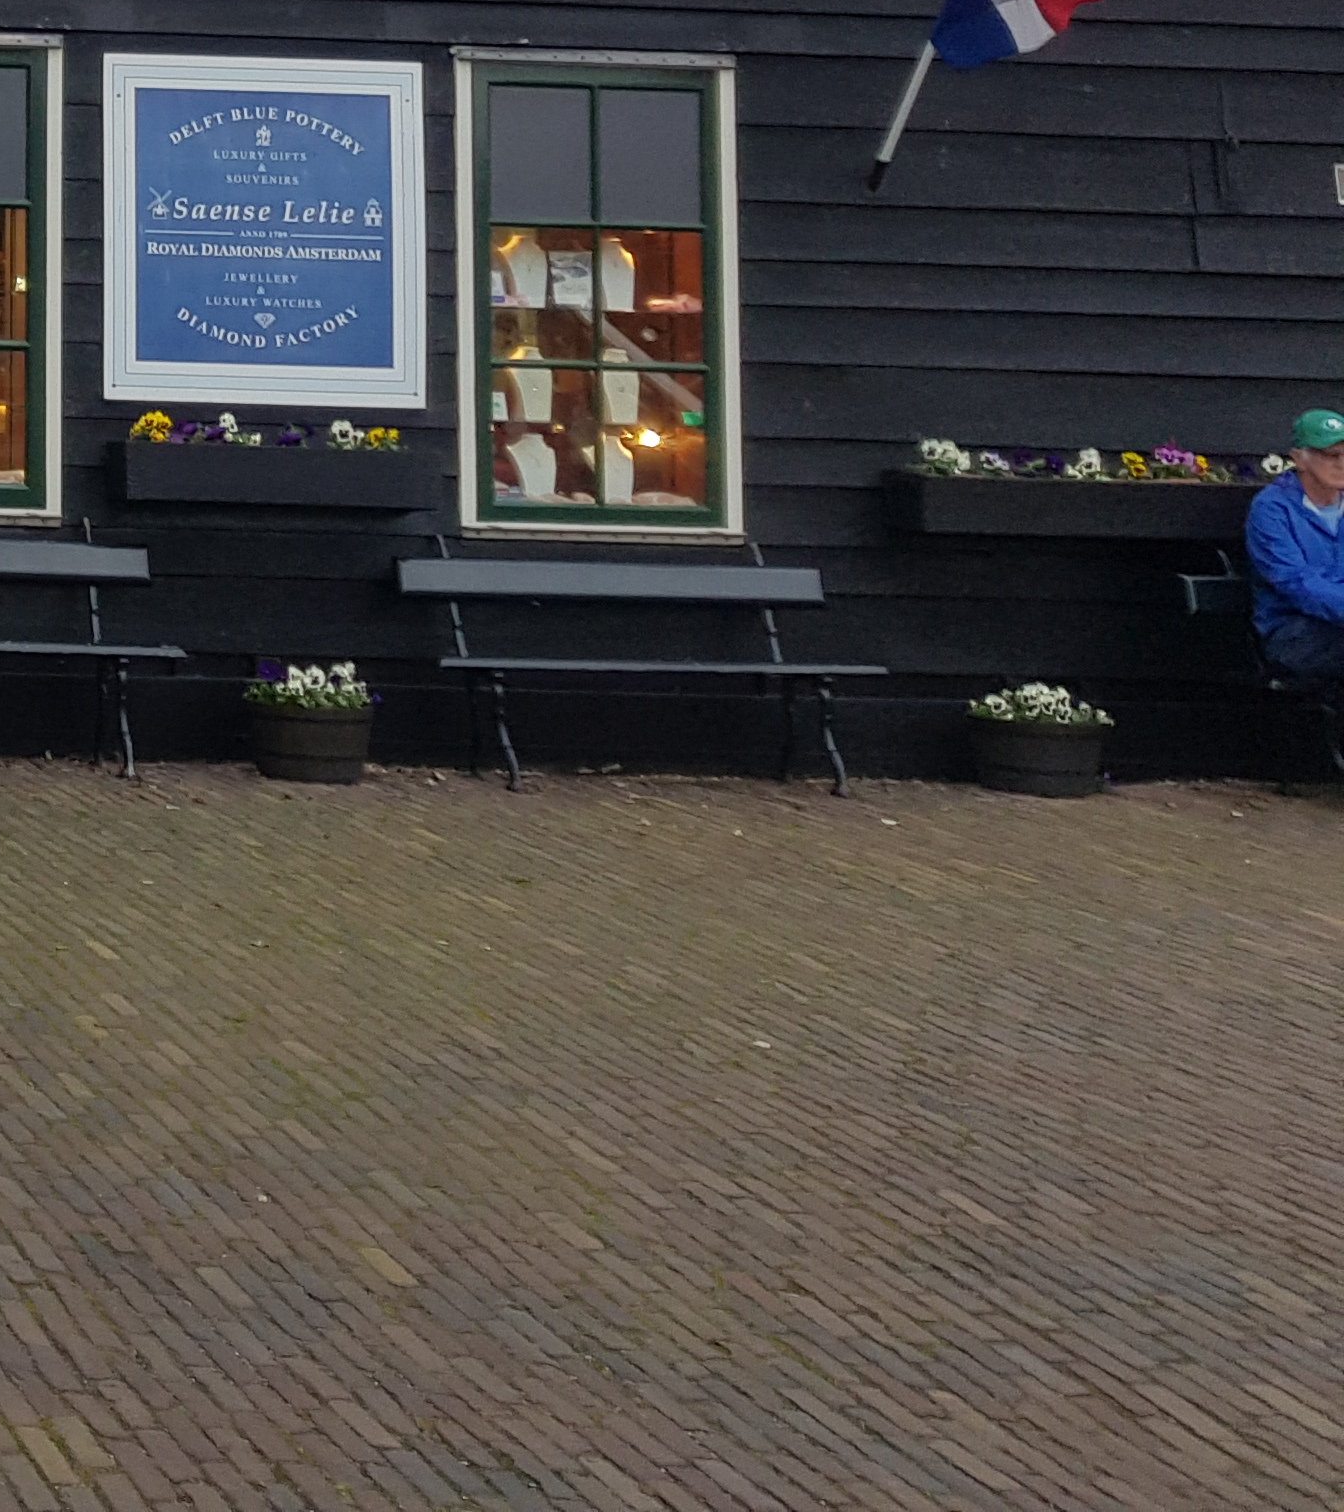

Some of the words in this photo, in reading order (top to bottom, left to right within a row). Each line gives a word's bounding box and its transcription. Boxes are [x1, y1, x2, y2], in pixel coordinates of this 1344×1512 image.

[169, 112, 225, 145] DELFT
[231, 107, 278, 121] BLUE
[285, 110, 365, 157] POTTERY
[213, 150, 264, 161] LUXURY
[270, 151, 307, 162] GIFTS
[226, 175, 299, 185] SOUVENIRS
[173, 198, 271, 223] Saense
[283, 200, 354, 224] Lelie
[146, 242, 198, 256] ROYAL
[201, 243, 283, 258] DIAMONDS
[285, 245, 382, 261] AMSTERDAM
[224, 273, 298, 284] JEWELLERY
[205, 296, 258, 307] LUXURY
[263, 298, 322, 309] WATCHES
[177, 308, 266, 348] DIAMOND
[275, 305, 359, 347] FACTORY
